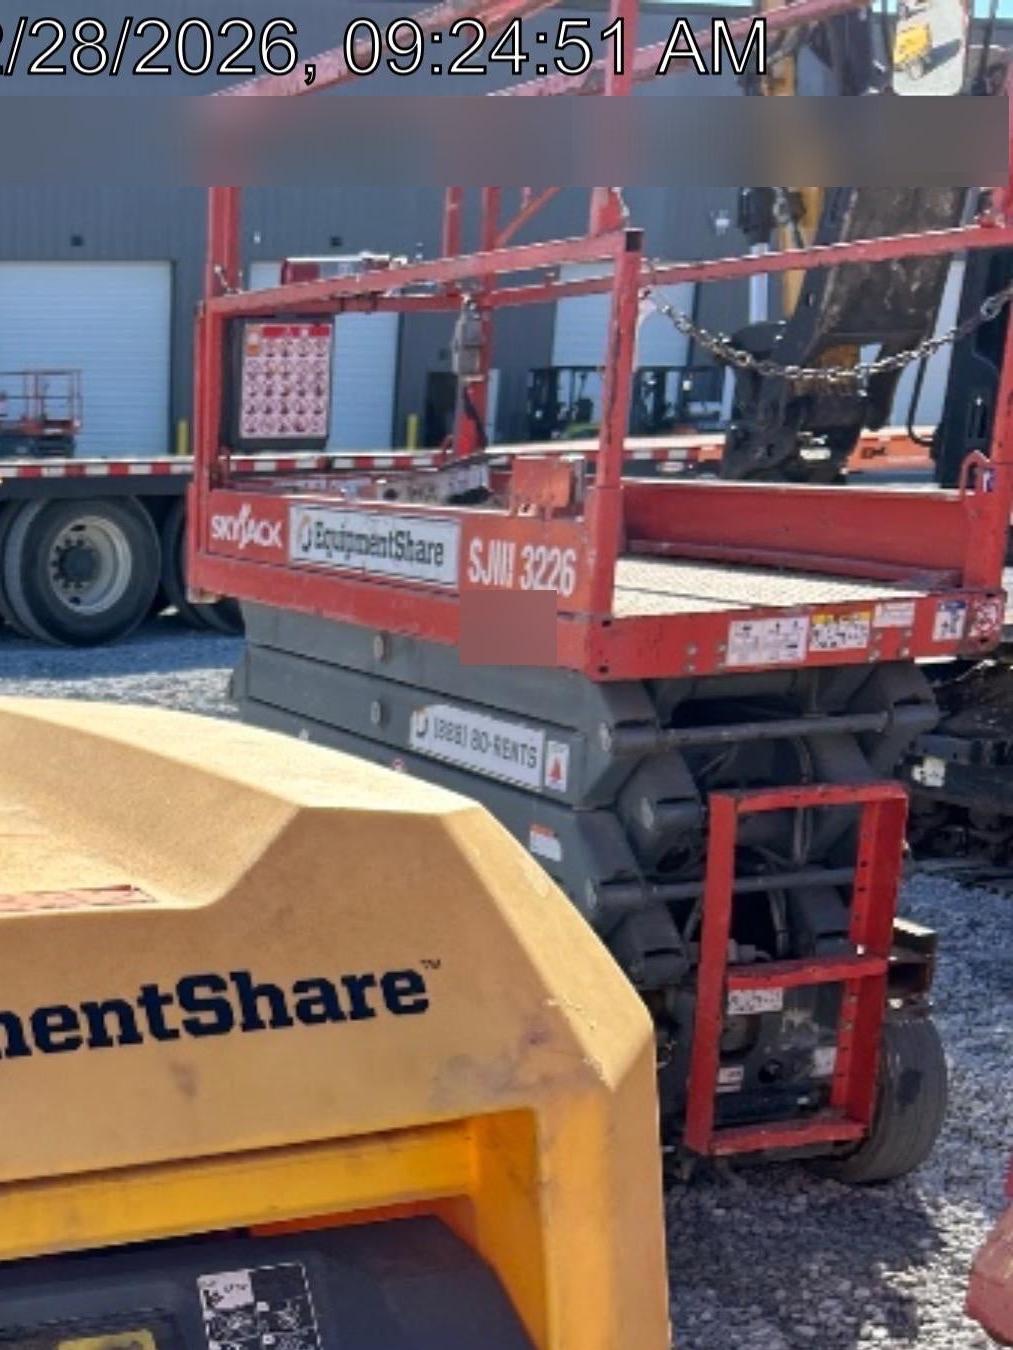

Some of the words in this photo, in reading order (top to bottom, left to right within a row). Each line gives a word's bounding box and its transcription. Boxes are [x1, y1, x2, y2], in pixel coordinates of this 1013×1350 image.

[211, 503, 282, 550] SKYJACK
[314, 510, 445, 567] EquipmentShare
[519, 546, 577, 598] 3226
